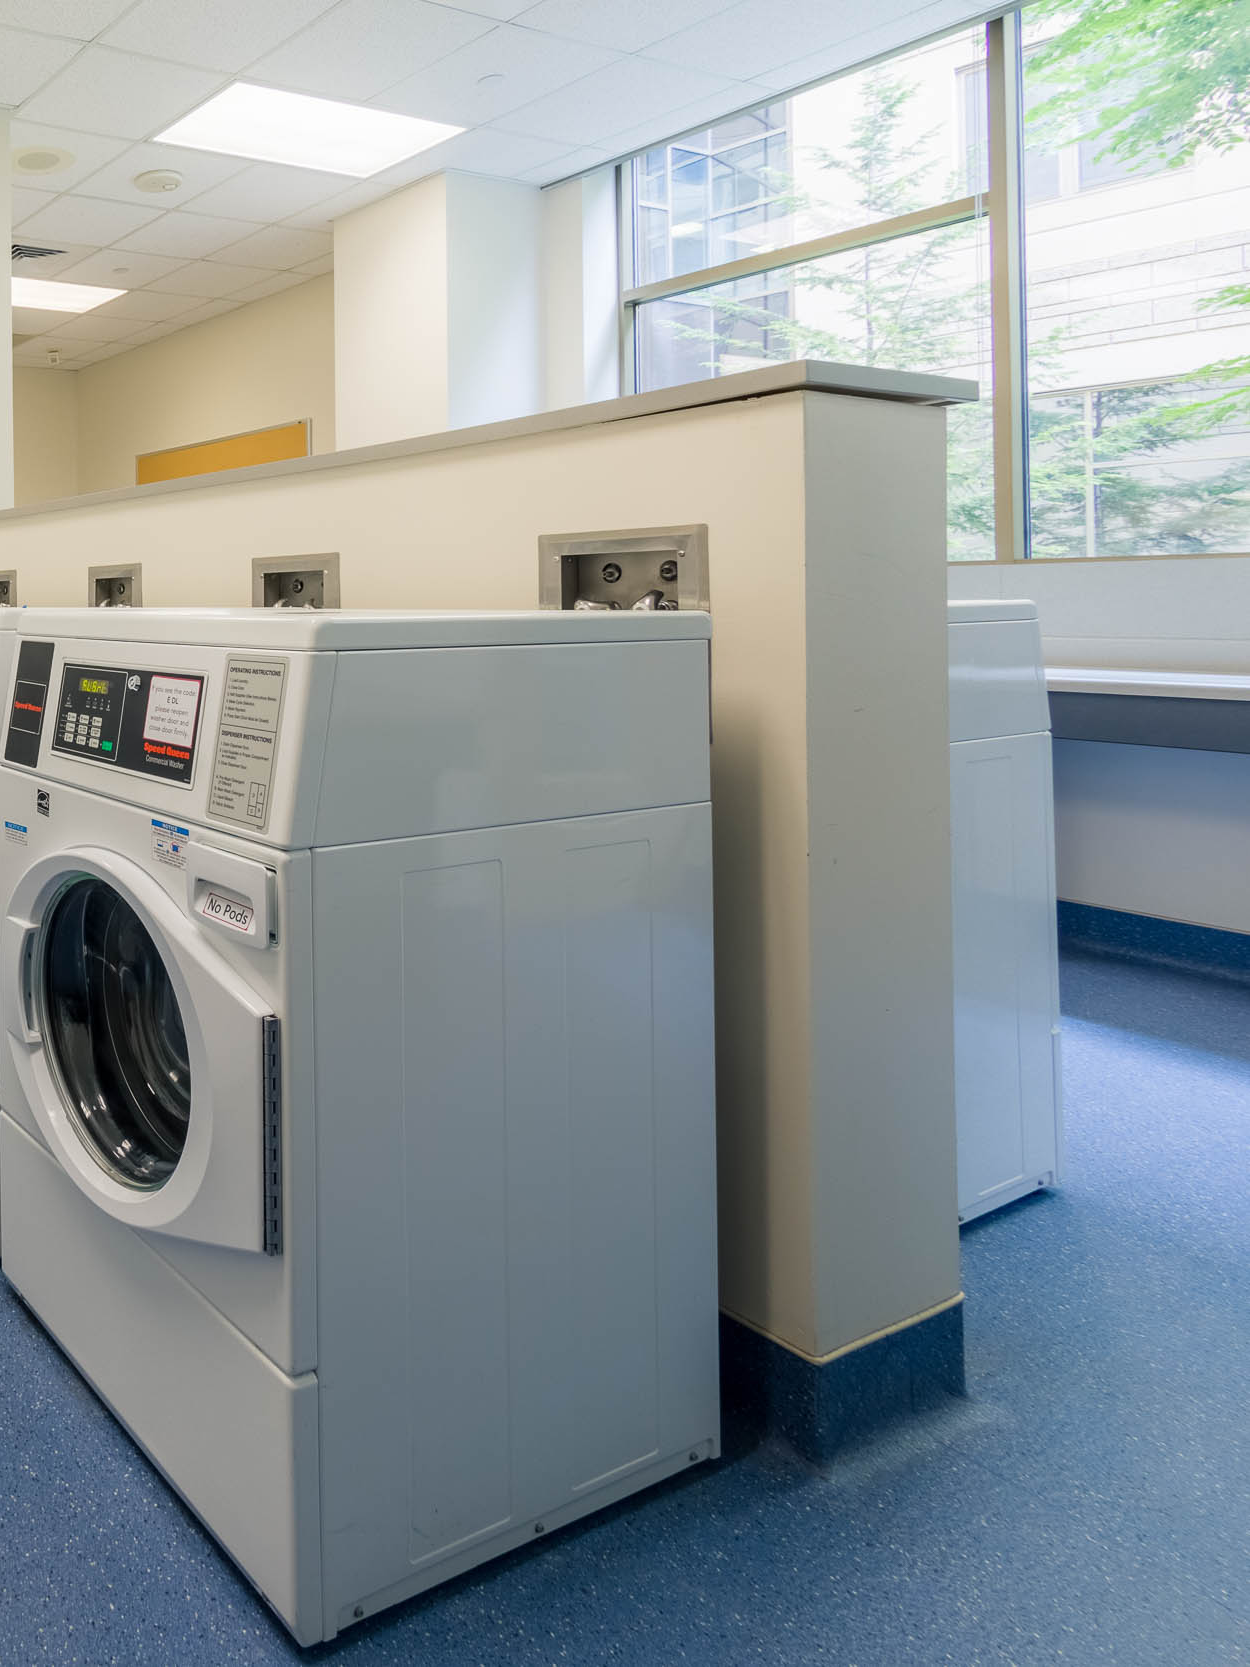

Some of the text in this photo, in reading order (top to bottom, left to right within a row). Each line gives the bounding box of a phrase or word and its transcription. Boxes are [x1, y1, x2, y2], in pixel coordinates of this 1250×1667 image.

[230, 667, 281, 677] OPERATING INSTRUCTIONS
[221, 730, 272, 744] DISPENSER INSTRUCTIONS
[144, 742, 190, 760] Speed Queen
[207, 898, 249, 926] No Pods
